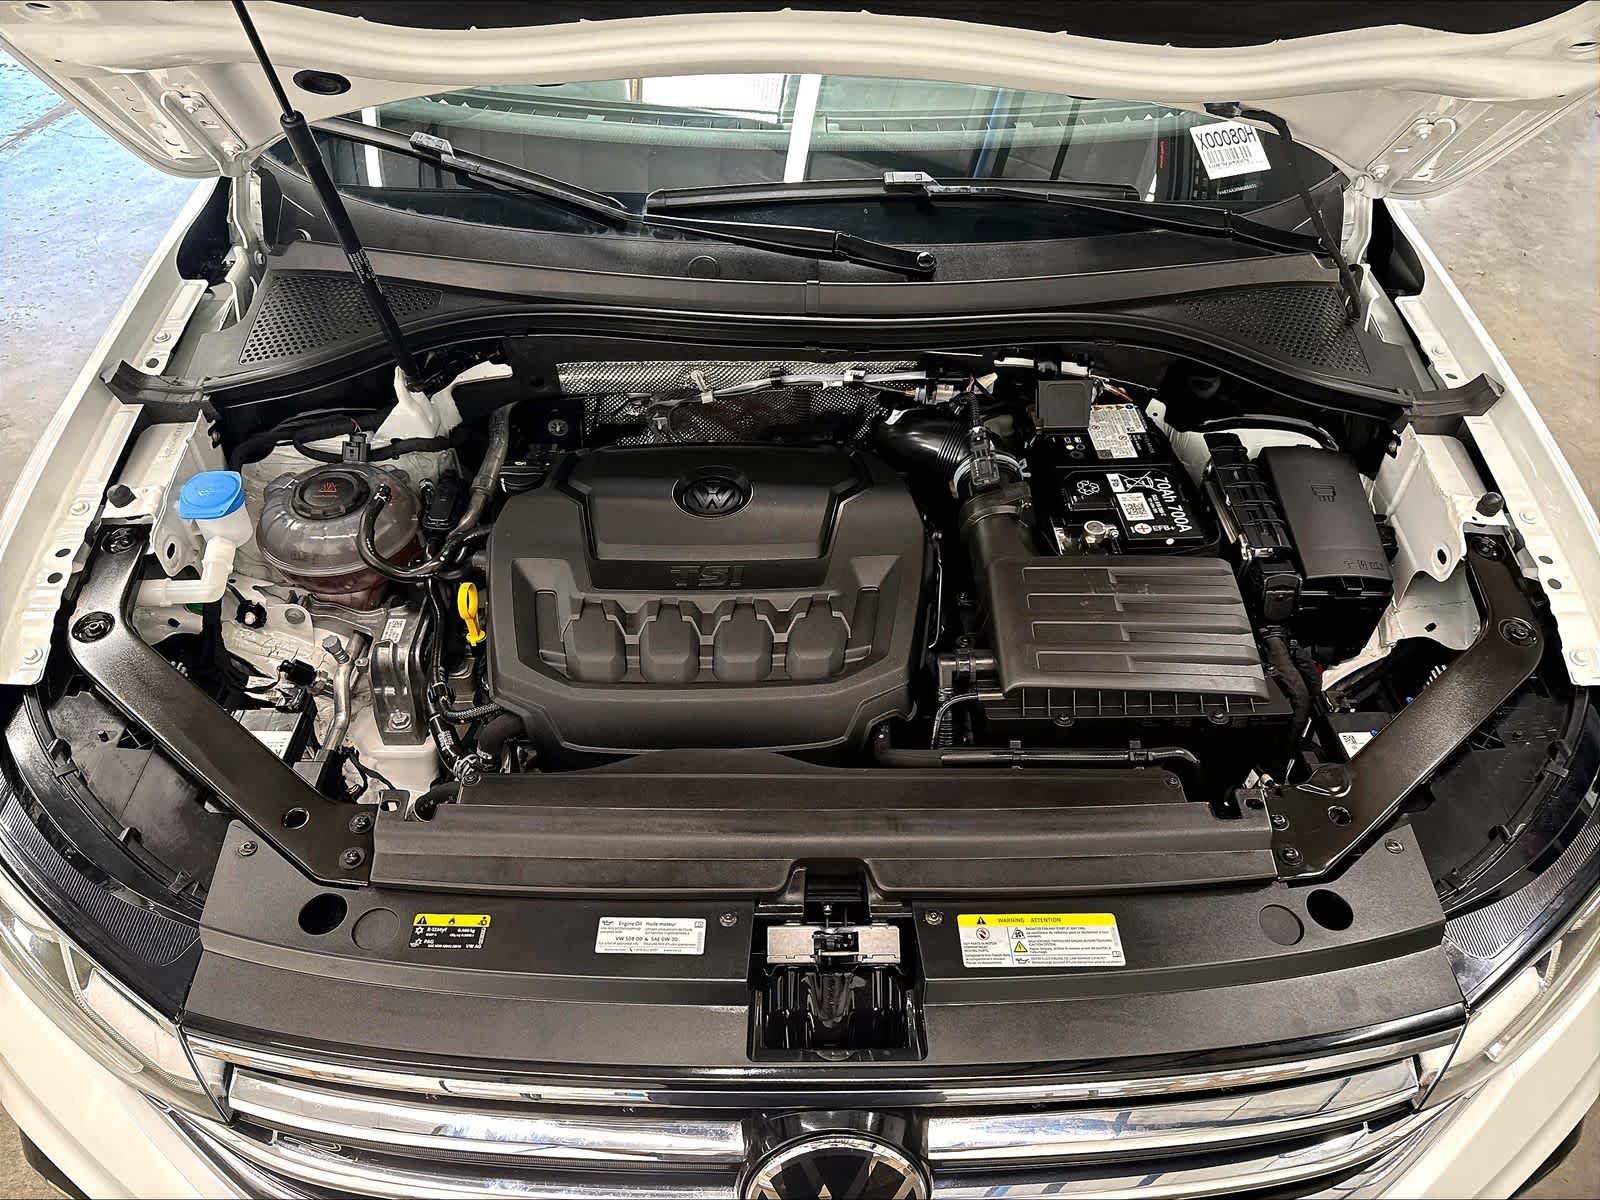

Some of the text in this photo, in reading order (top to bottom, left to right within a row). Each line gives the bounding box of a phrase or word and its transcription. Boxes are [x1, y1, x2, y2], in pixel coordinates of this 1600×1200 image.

[1154, 476, 1177, 502] 70Ah
[1168, 504, 1193, 533] 700A
[669, 565, 745, 587] TSI
